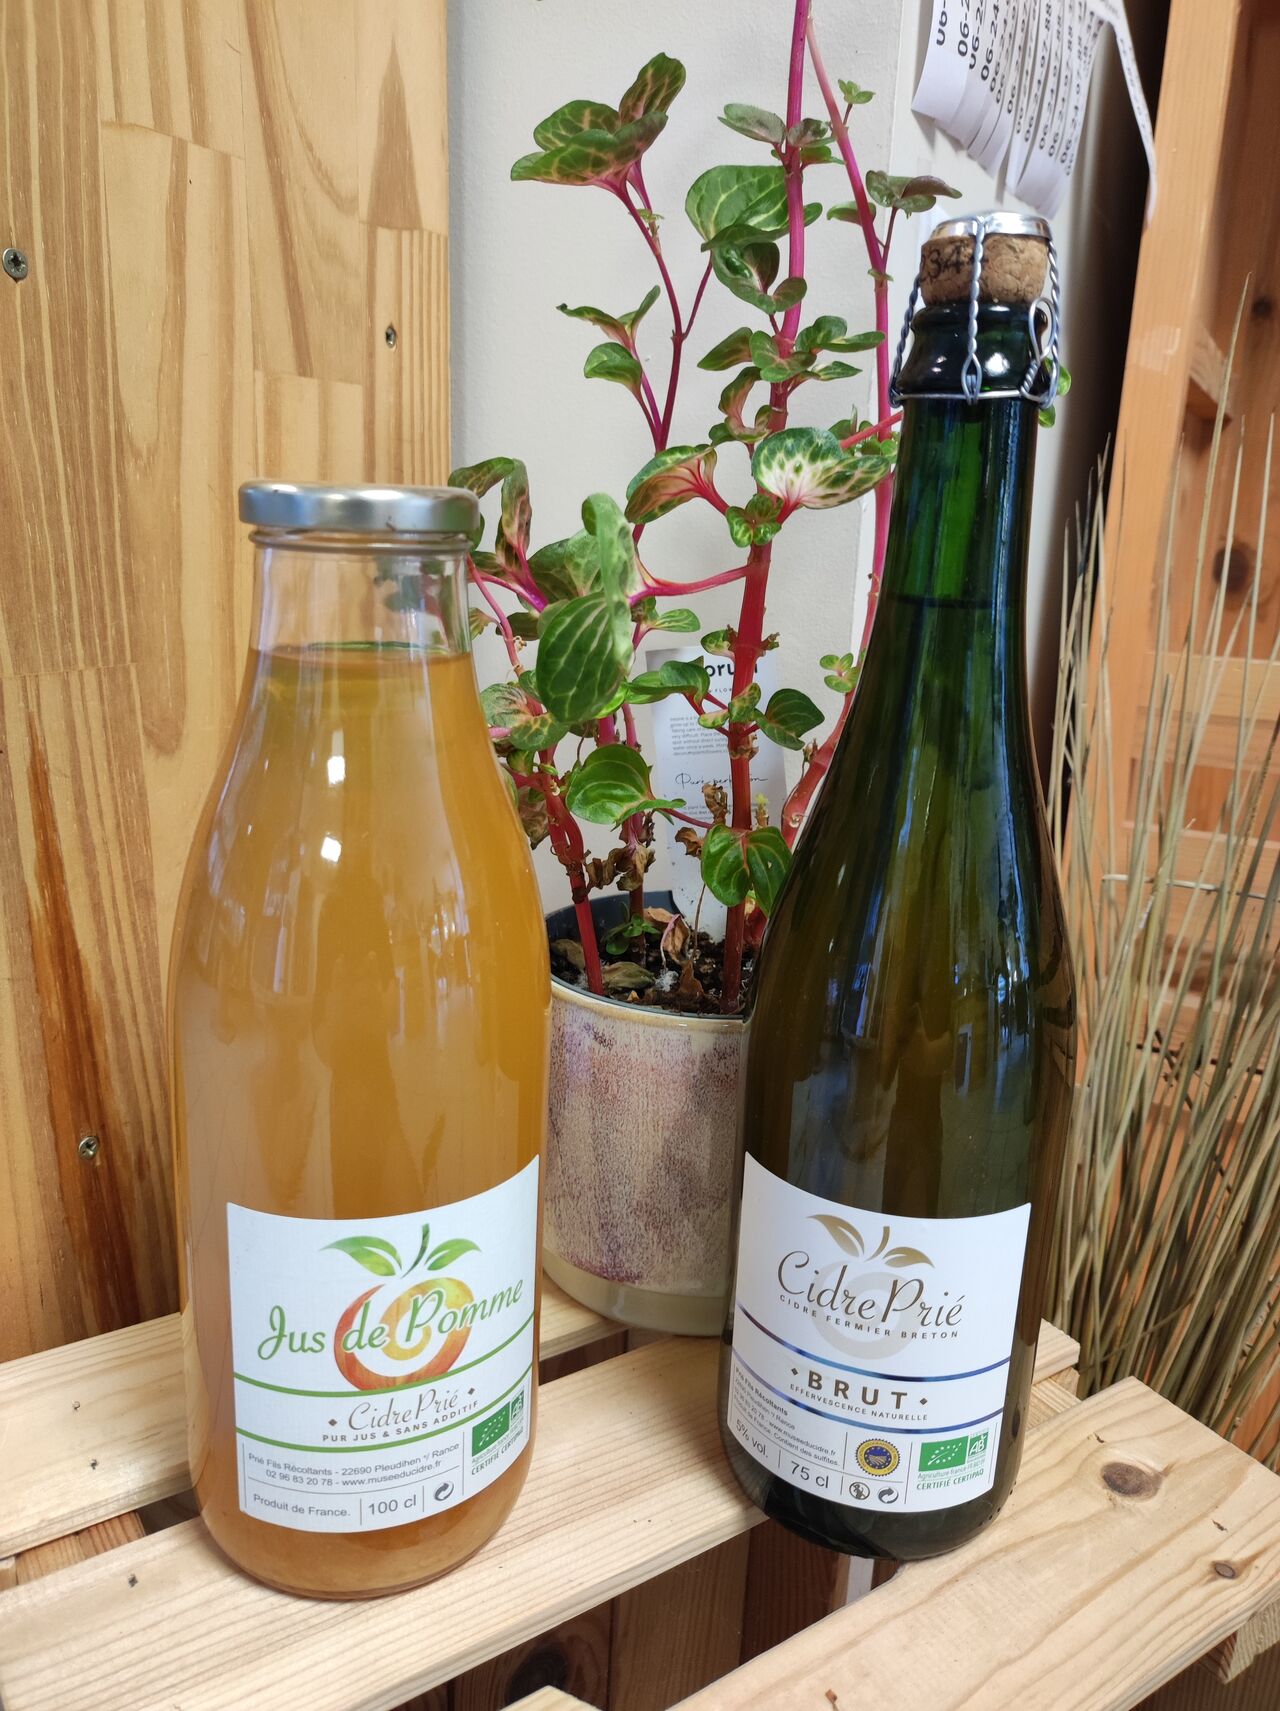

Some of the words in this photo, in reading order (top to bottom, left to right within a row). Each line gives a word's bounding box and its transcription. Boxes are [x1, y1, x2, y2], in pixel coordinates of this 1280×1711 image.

[257, 1305, 326, 1360] Jus
[342, 1299, 387, 1353] de
[404, 1279, 524, 1343] Pomme
[779, 1294, 818, 1318] CIDRE
[826, 1314, 891, 1337] FERMIER
[901, 1330, 958, 1340] BRETON
[790, 1383, 867, 1415] EFFERVESCENCE
[871, 1410, 928, 1421] NATURELLE
[807, 1370, 908, 1410] BRUT
[322, 1434, 347, 1442] PUR
[353, 1432, 376, 1441] JUS
[396, 1421, 428, 1435] SANS
[433, 1400, 479, 1425] ADDITIF
[248, 1453, 265, 1465] Prié
[266, 1459, 281, 1470] Fils
[283, 1462, 332, 1476] Récoltants
[341, 1465, 372, 1476] 22690
[374, 1456, 421, 1473] Pleudihen
[432, 1442, 460, 1458] Rance
[751, 1438, 769, 1459] vol.
[800, 1447, 812, 1458] des
[265, 1469, 277, 1478] 02
[279, 1472, 291, 1482] 96
[292, 1475, 304, 1484] 83
[306, 1476, 318, 1486] 20
[321, 1477, 333, 1486] 78
[342, 1460, 442, 1486] www.museeducidre.fr
[791, 1460, 811, 1481] 75
[815, 1475, 829, 1489] cl
[953, 1468, 985, 1485] CERTIPAQ
[253, 1493, 289, 1512] Produit
[291, 1503, 305, 1514] de
[308, 1506, 351, 1517] France.
[368, 1499, 398, 1515] 100
[403, 1494, 417, 1508] cl
